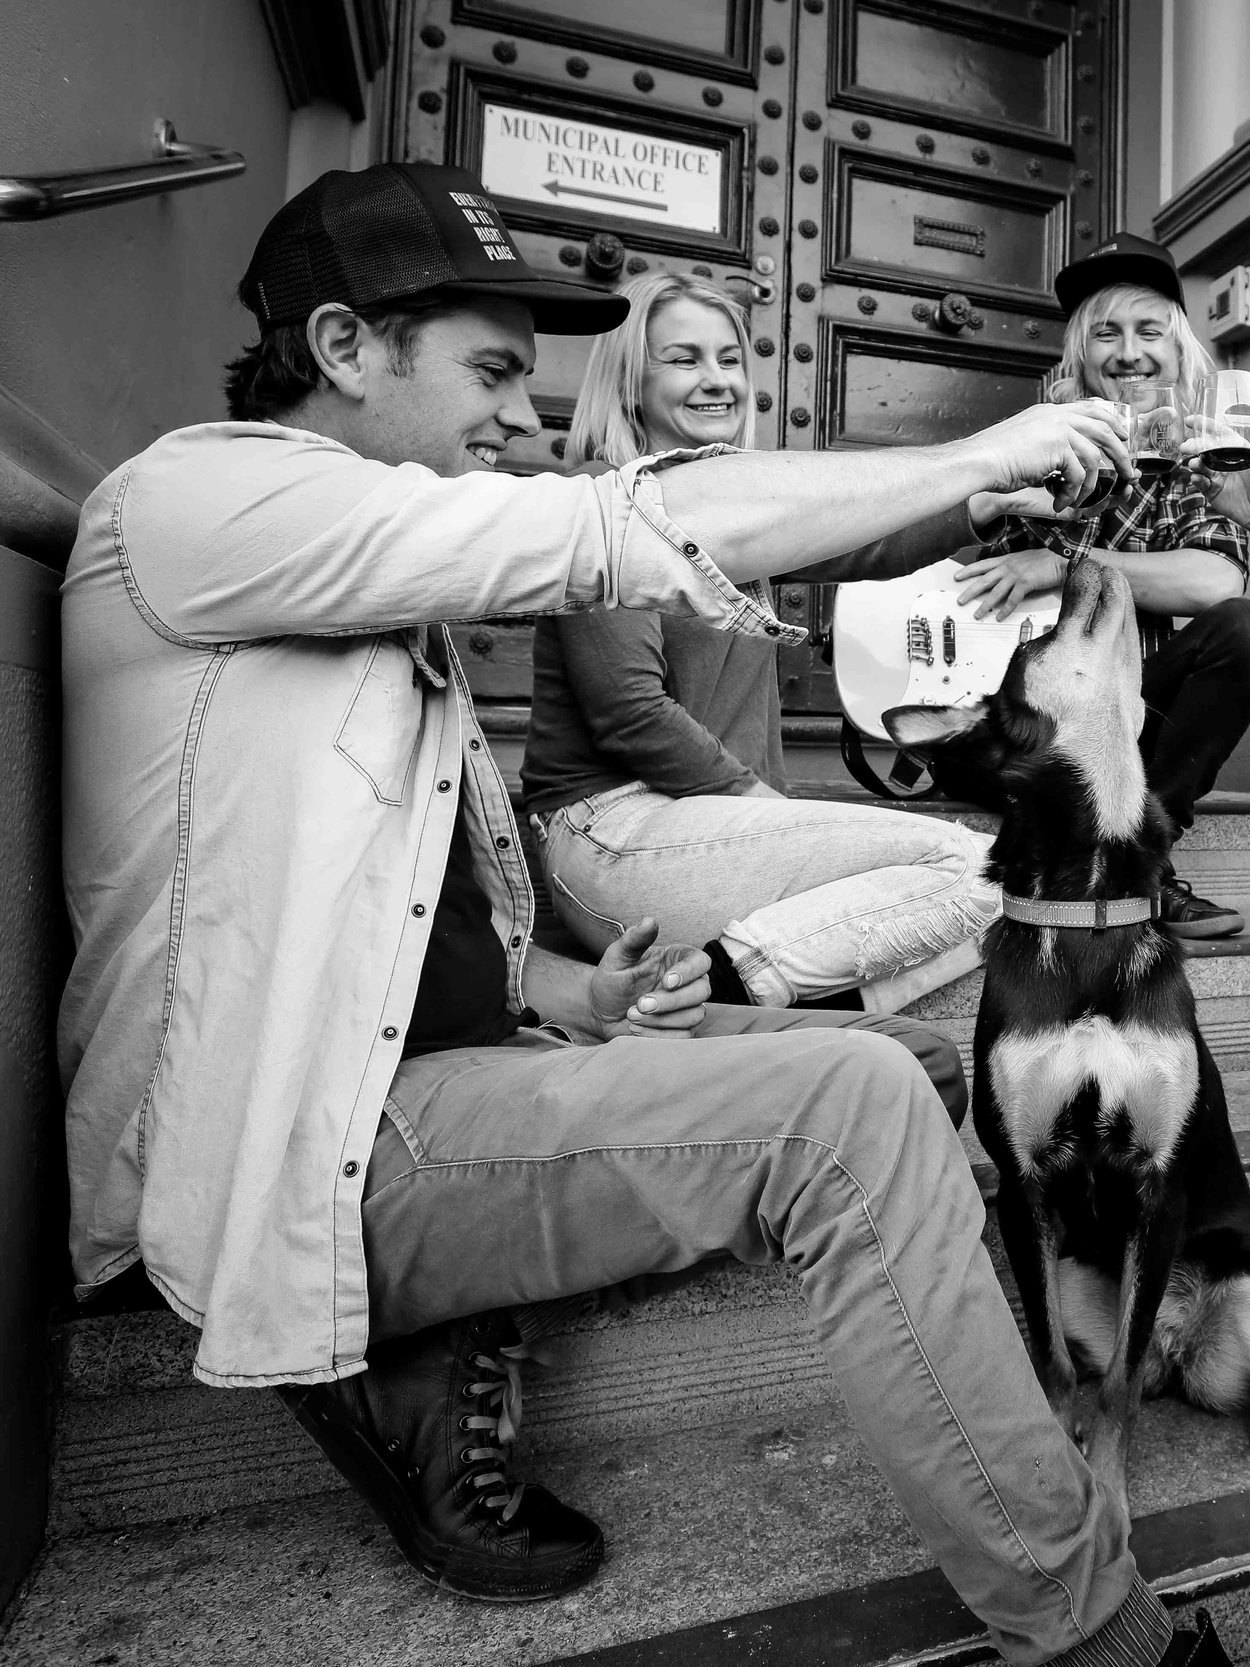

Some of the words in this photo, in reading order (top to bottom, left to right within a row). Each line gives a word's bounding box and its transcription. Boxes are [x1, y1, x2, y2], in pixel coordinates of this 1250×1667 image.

[500, 115, 626, 158] MUNICIPAL
[633, 141, 709, 174] OFFICE
[546, 152, 665, 192] ENTRANCE
[461, 209, 479, 224] IN
[475, 209, 495, 226] ITS
[473, 227, 505, 243] RIGHT
[483, 245, 516, 261] PLACE
